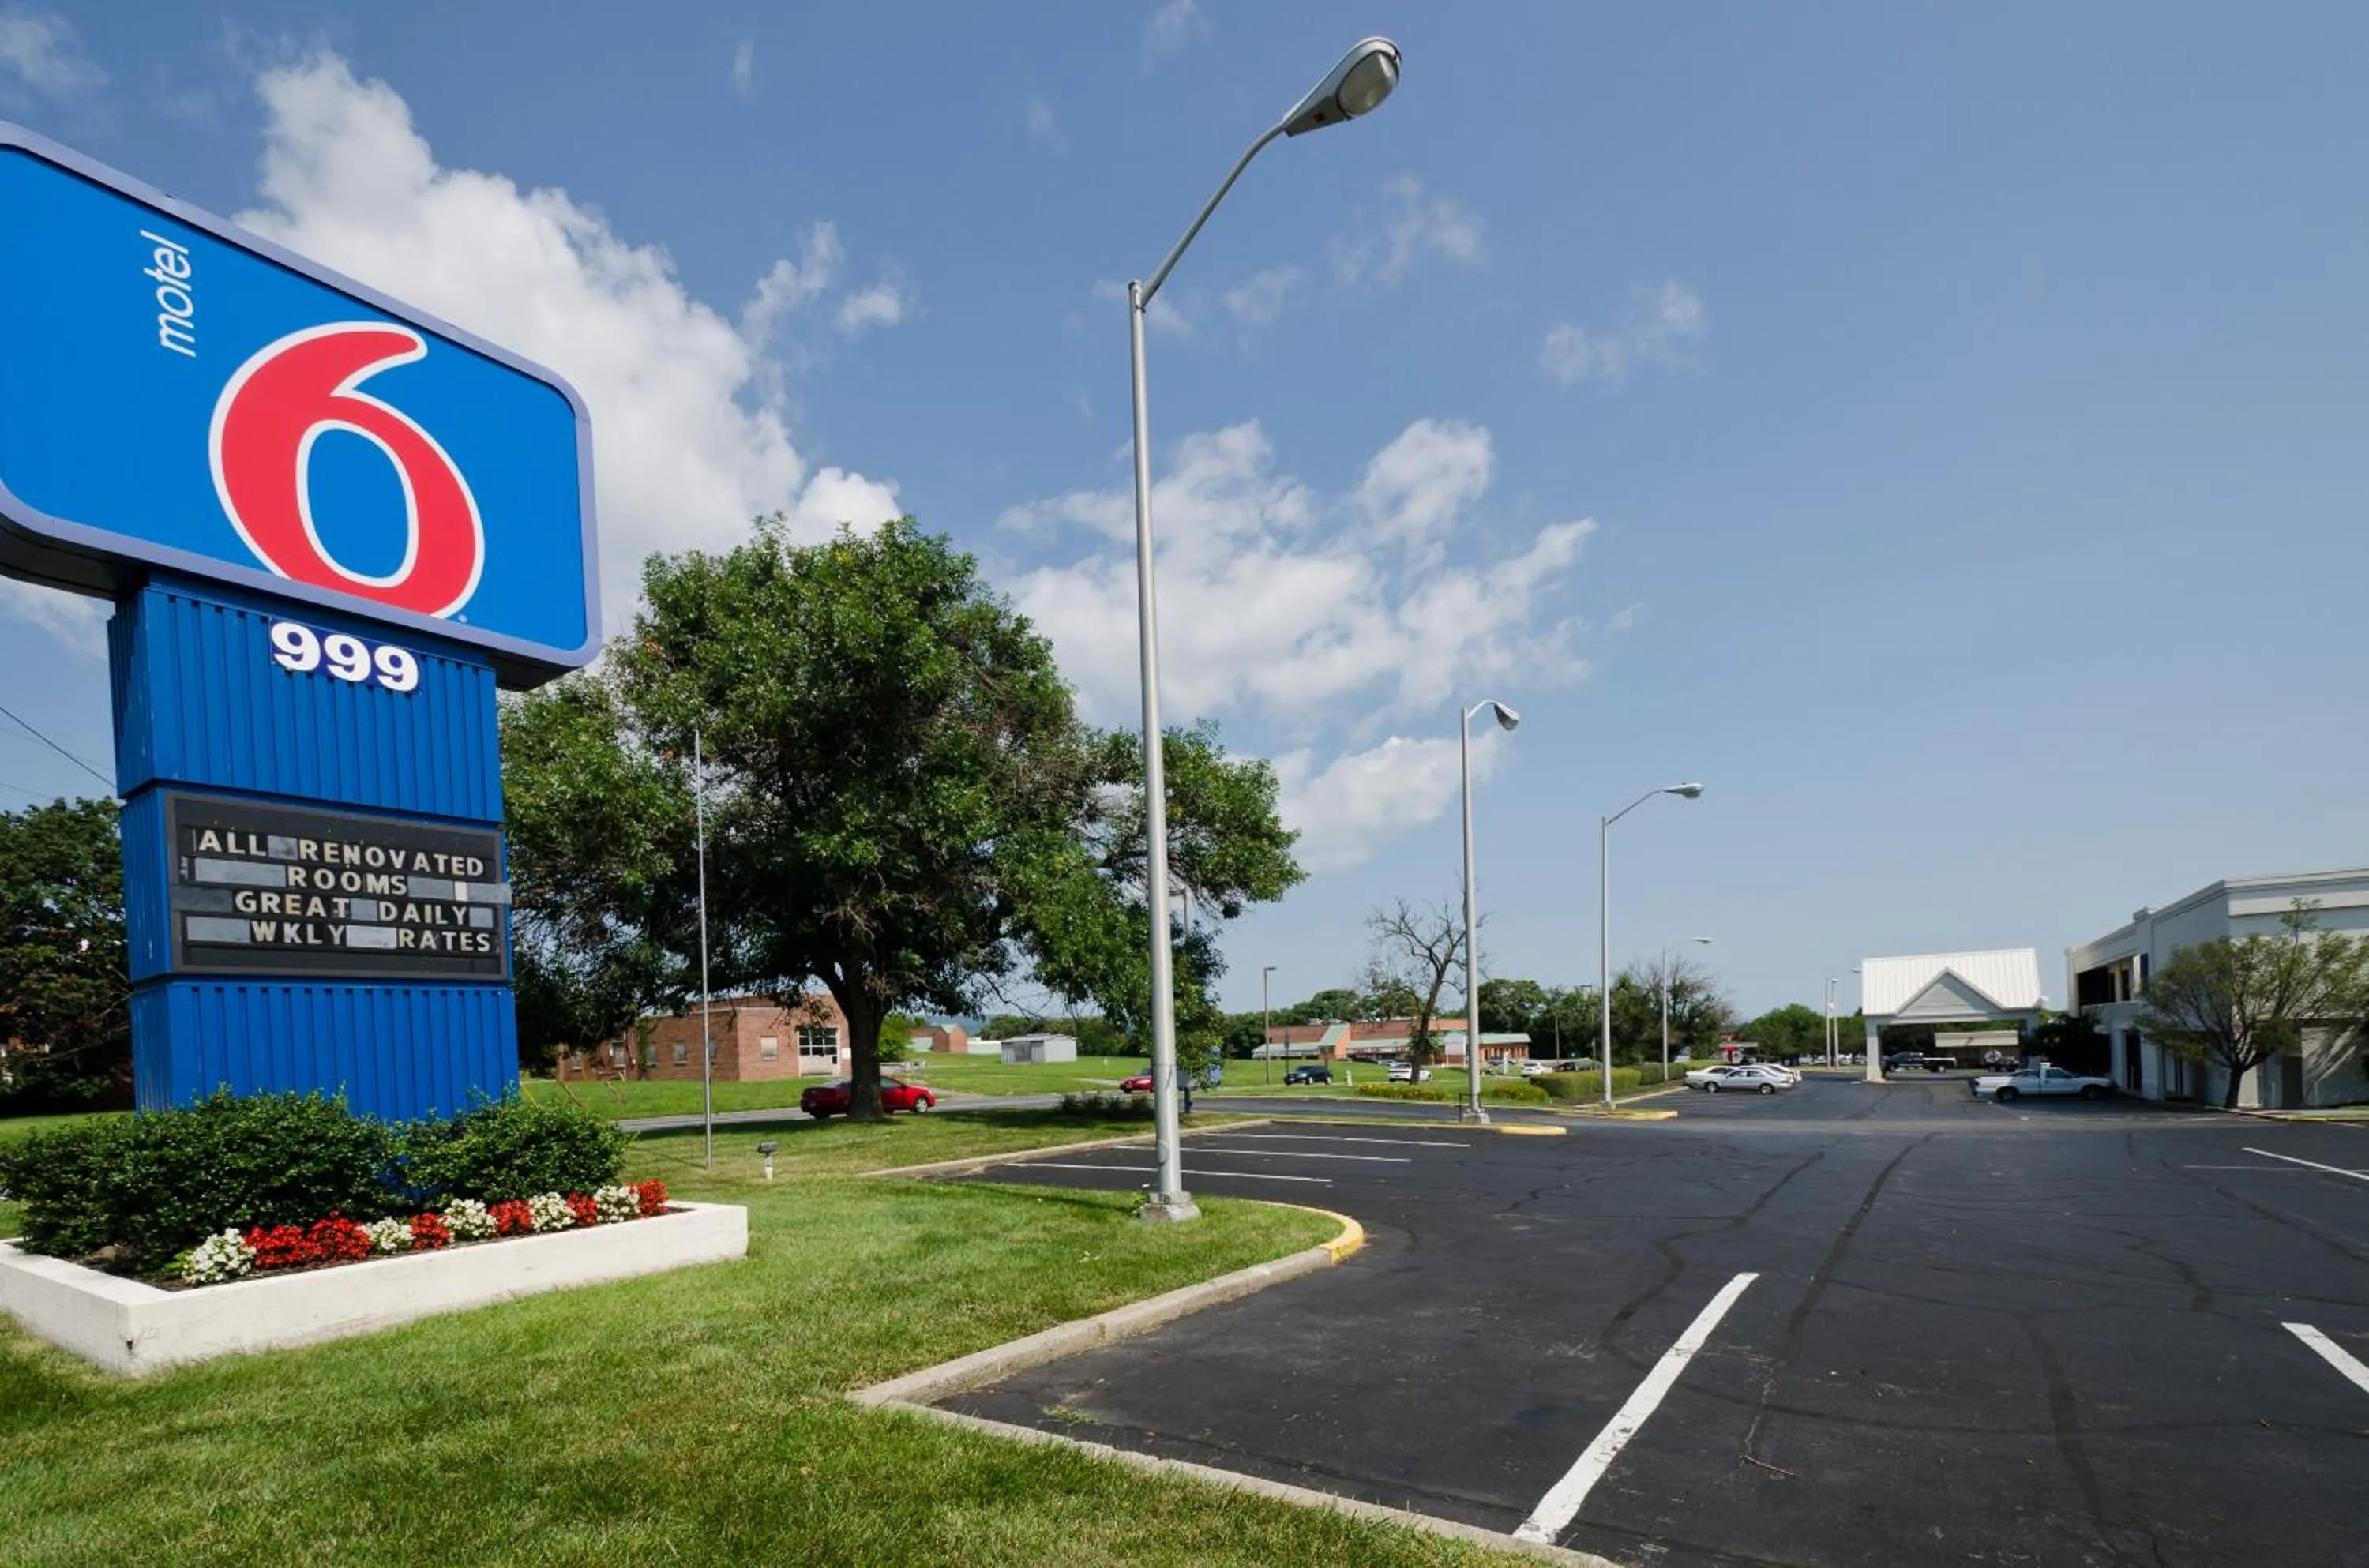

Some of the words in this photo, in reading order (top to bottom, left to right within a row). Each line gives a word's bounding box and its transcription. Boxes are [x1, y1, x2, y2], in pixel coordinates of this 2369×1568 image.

[139, 229, 197, 358] motel
[208, 321, 486, 619] 6
[271, 621, 419, 692] 999
[198, 830, 267, 857] ALL
[298, 839, 484, 876] RENOVATED
[287, 866, 407, 896] ROOMS
[235, 891, 350, 918] GREAT
[378, 901, 467, 925] DAILY
[251, 921, 345, 945] WKLY
[399, 928, 490, 952] RATES
